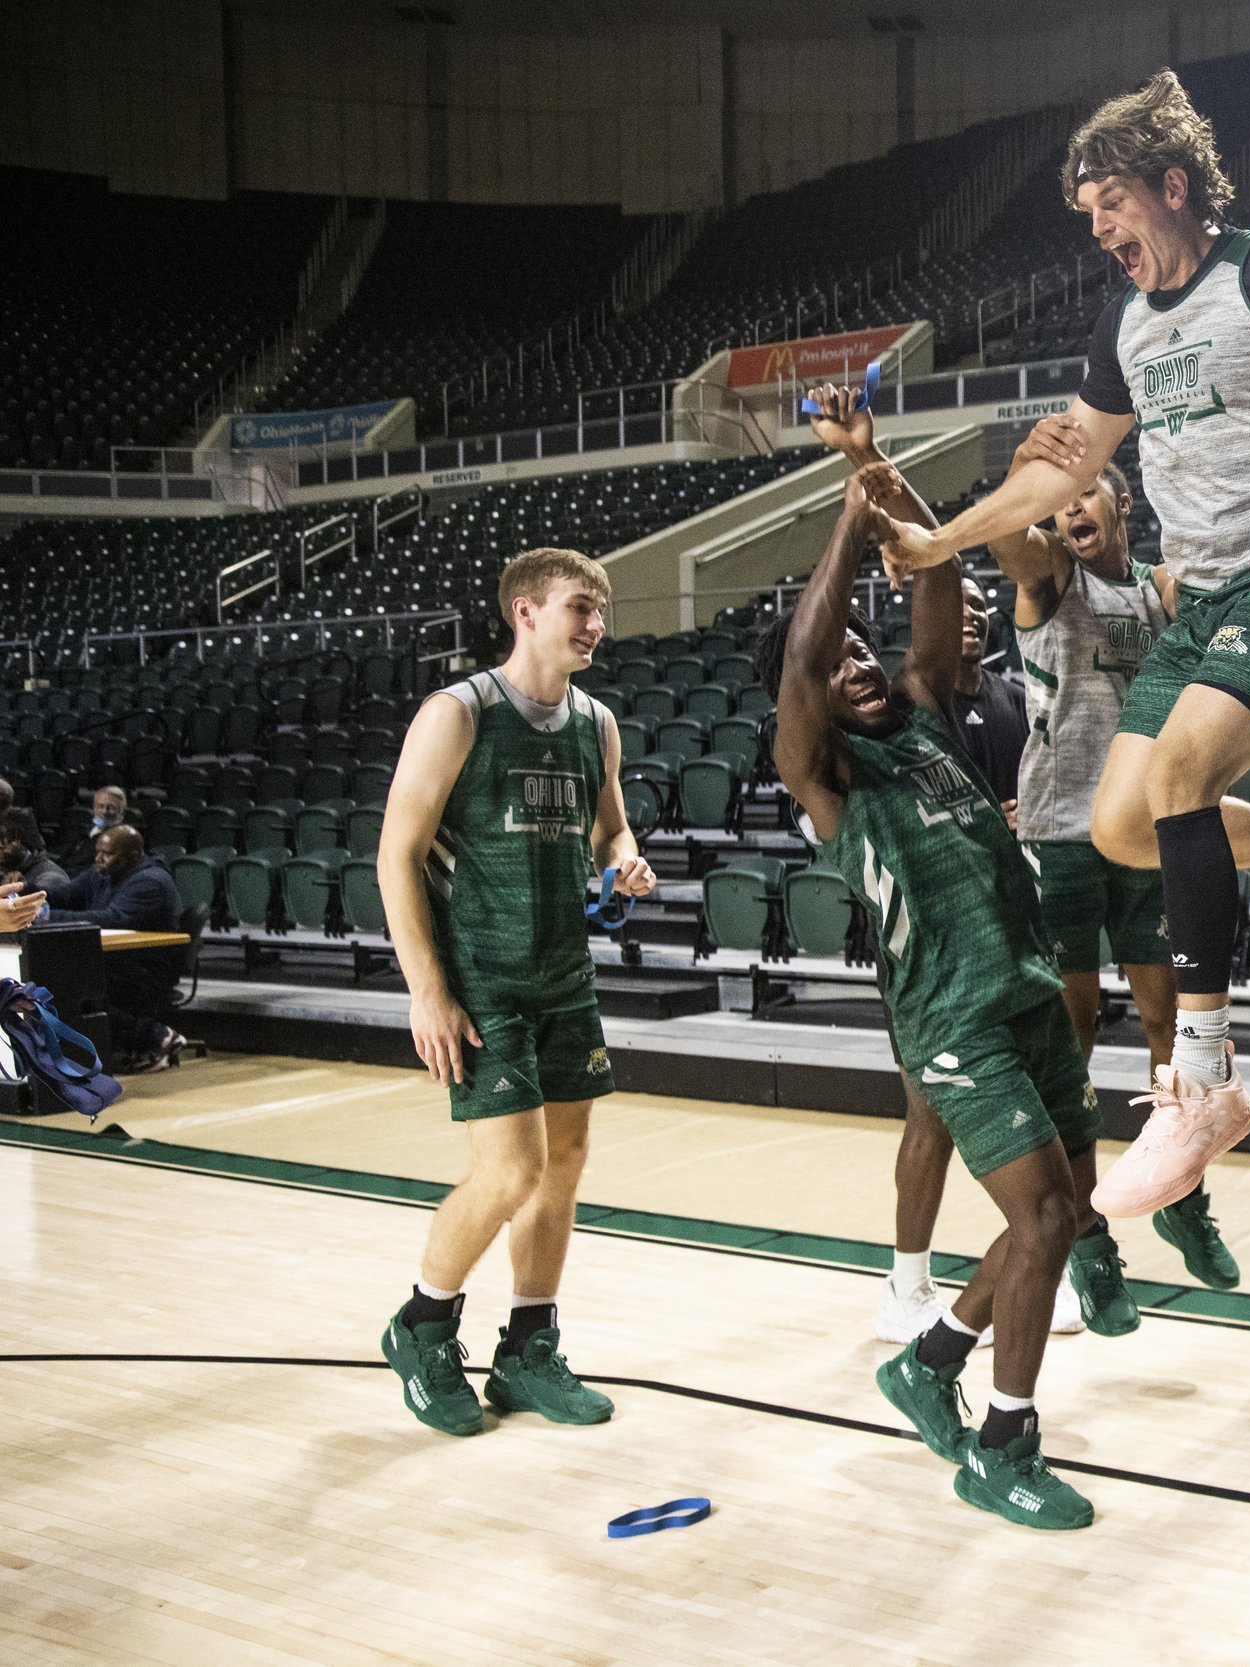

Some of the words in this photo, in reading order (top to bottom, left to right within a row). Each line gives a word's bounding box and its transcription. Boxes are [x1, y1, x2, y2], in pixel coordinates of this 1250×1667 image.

[1144, 353, 1199, 399] OHIO
[997, 401, 1068, 418] RESERVED
[1142, 390, 1206, 410] BASKETBALL
[432, 470, 481, 484] RESERVED
[525, 777, 577, 808] OHIO
